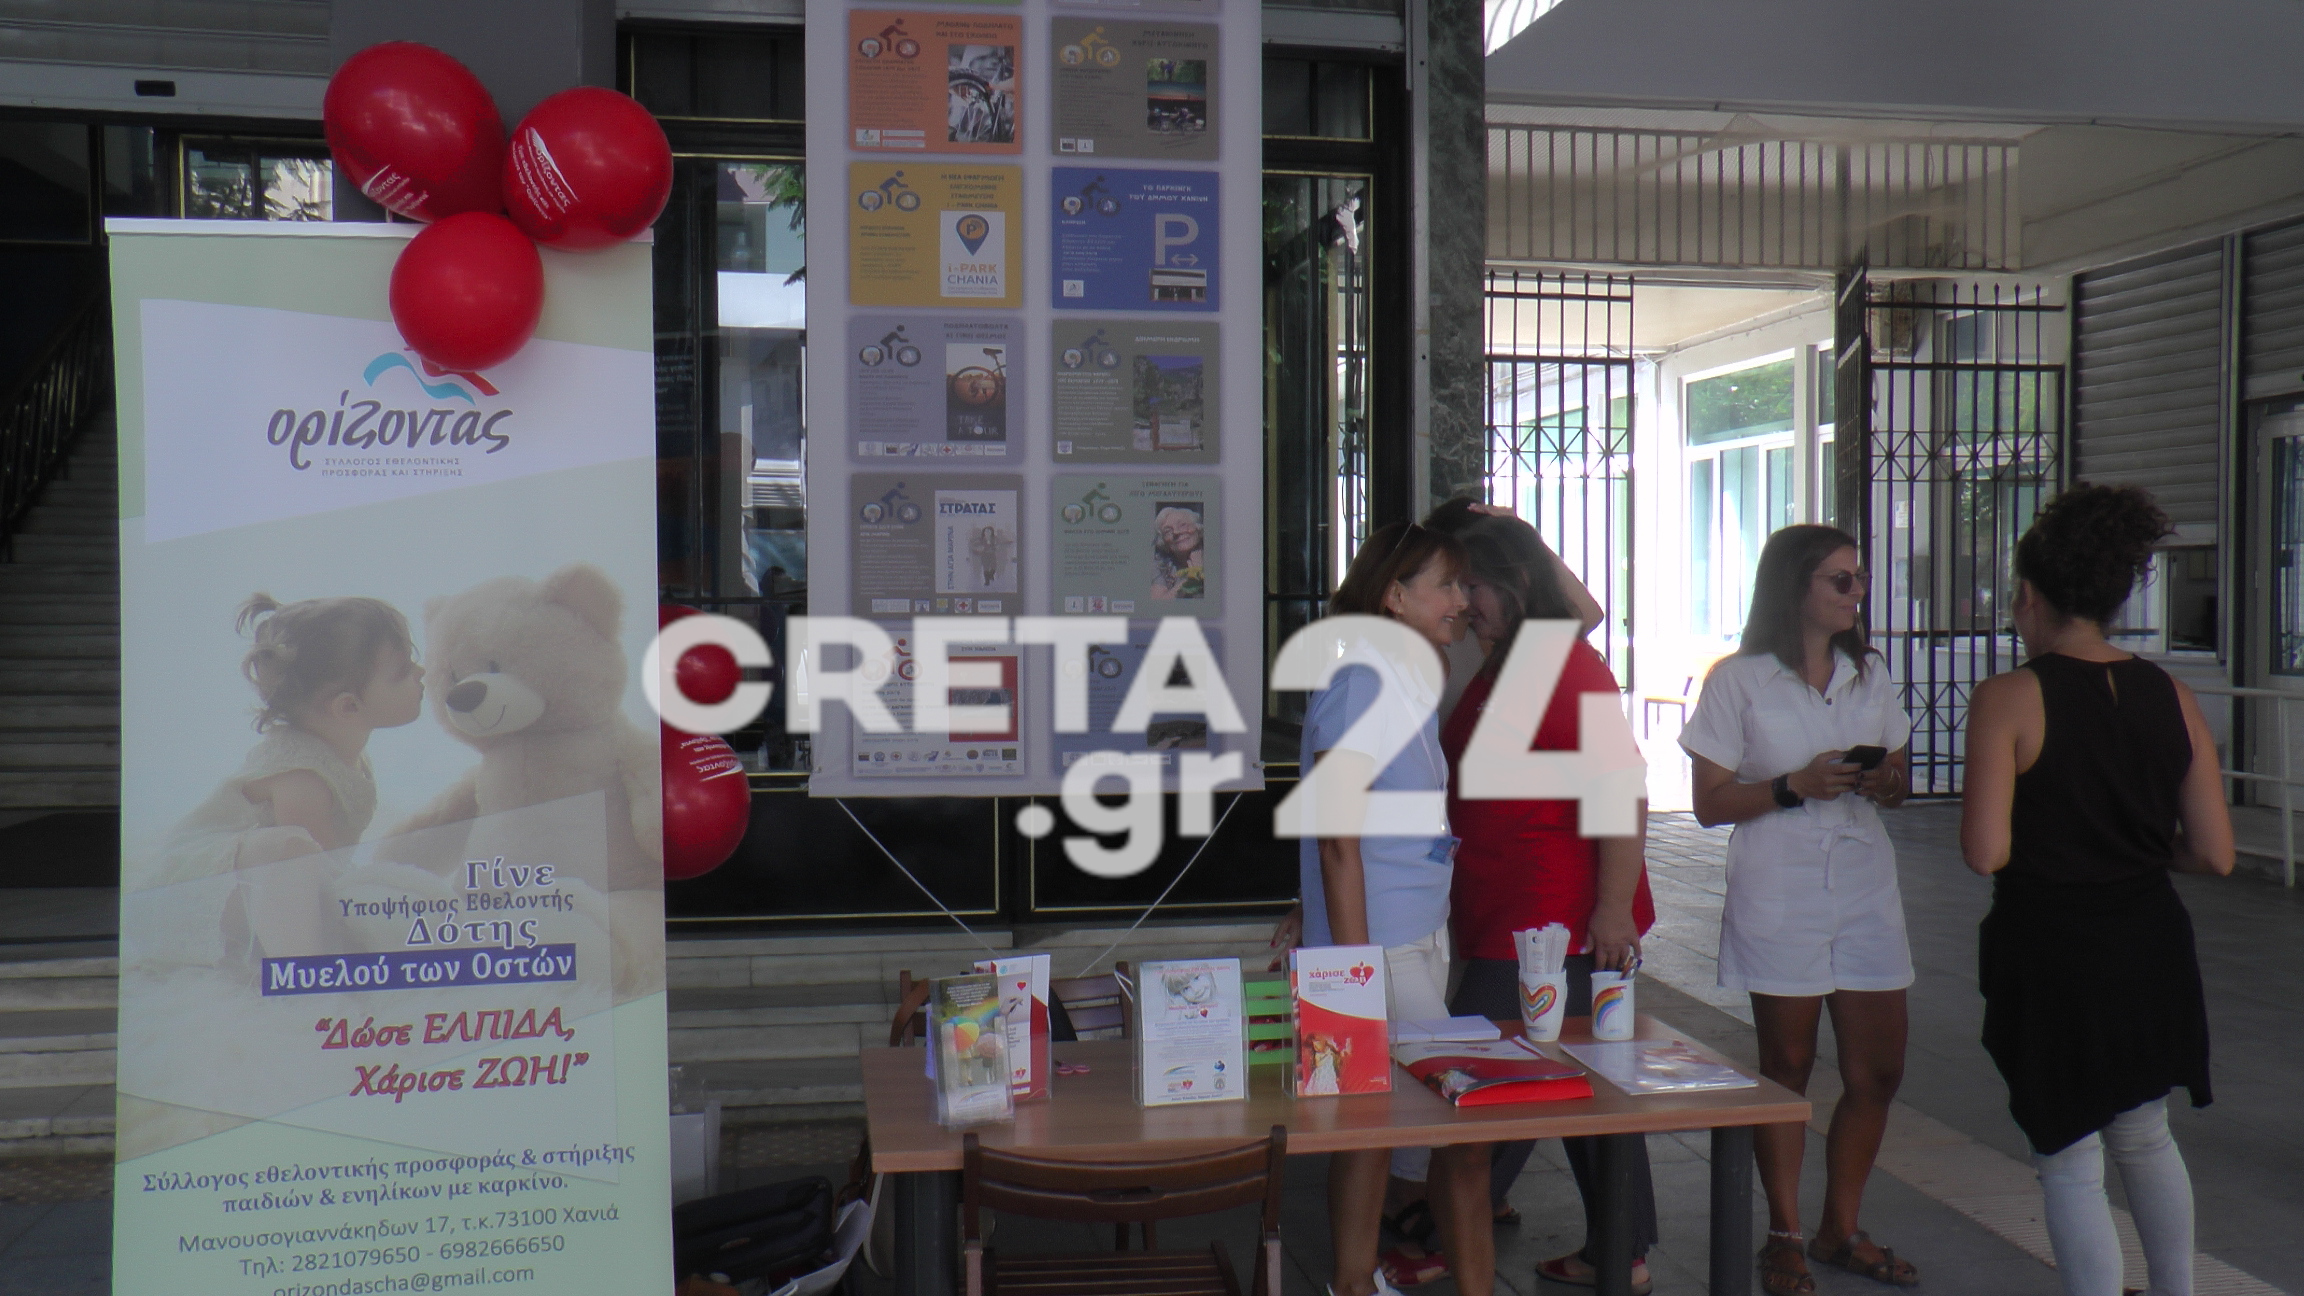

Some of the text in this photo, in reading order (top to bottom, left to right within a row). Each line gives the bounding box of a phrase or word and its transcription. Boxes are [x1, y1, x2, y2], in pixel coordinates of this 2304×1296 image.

[1155, 213, 1199, 265] P
[947, 274, 998, 285] CHANIA
[267, 390, 514, 471] ορίζοντας
[321, 468, 464, 477] ΠΡΟΣΦΟΡΑΣ ΚΑΙ ΣΤΗΡΙΞΗΣ
[324, 457, 460, 466] ΣΥΛΛΟΓΟΣ ΕΘΕΛΟΝΤΙΚΗΣ
[939, 503, 996, 514] ΣΤΡΑΤΑΣ
[465, 857, 555, 890] Γίνε
[339, 888, 574, 919] Υποψήφιος Εθελοντής
[405, 913, 539, 949] Δότης
[270, 948, 572, 990] Μυελού των Οστών
[1309, 968, 1345, 980] χάρισε
[422, 1006, 575, 1044] ΕΛΠΙΔΑ,
[349, 1063, 466, 1104] Χάρισε
[142, 1143, 636, 1193] Σύλλογος εθελοντικής προσφοράς & στήριξης
[222, 1171, 568, 1213] παιδιών & ενηλίκων με καρκίνο.
[178, 1203, 619, 1253] Μανουσογιαννάκηδων 17, τ.κ.73100 Χανιά
[239, 1256, 284, 1278] Τηλ:
[292, 1246, 420, 1272] 2821079650
[439, 1235, 565, 1260] 6982666650
